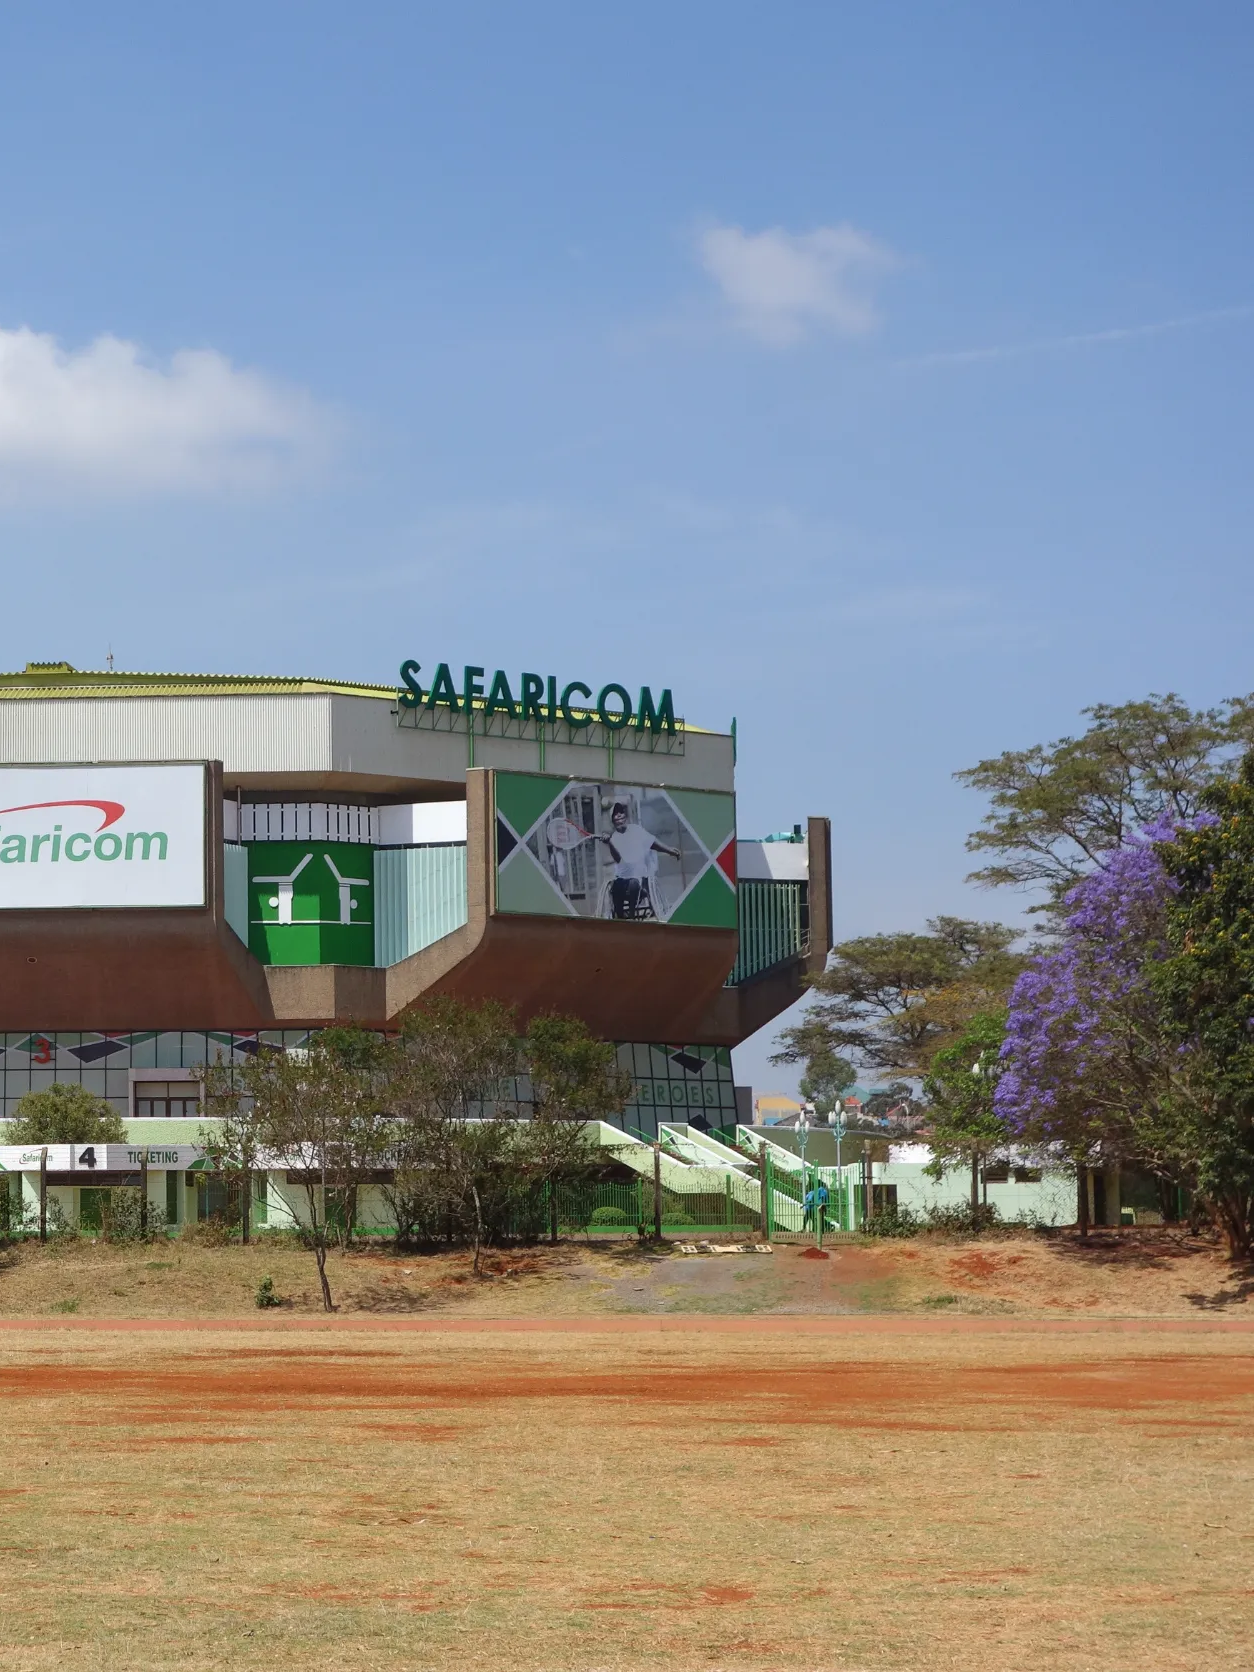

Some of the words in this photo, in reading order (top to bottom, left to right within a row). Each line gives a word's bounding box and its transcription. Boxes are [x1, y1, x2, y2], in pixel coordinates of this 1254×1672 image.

[399, 659, 677, 737] SAFARICOM
[34, 1037, 51, 1065] 3
[640, 1084, 714, 1104] EROES
[78, 1146, 97, 1168] 4
